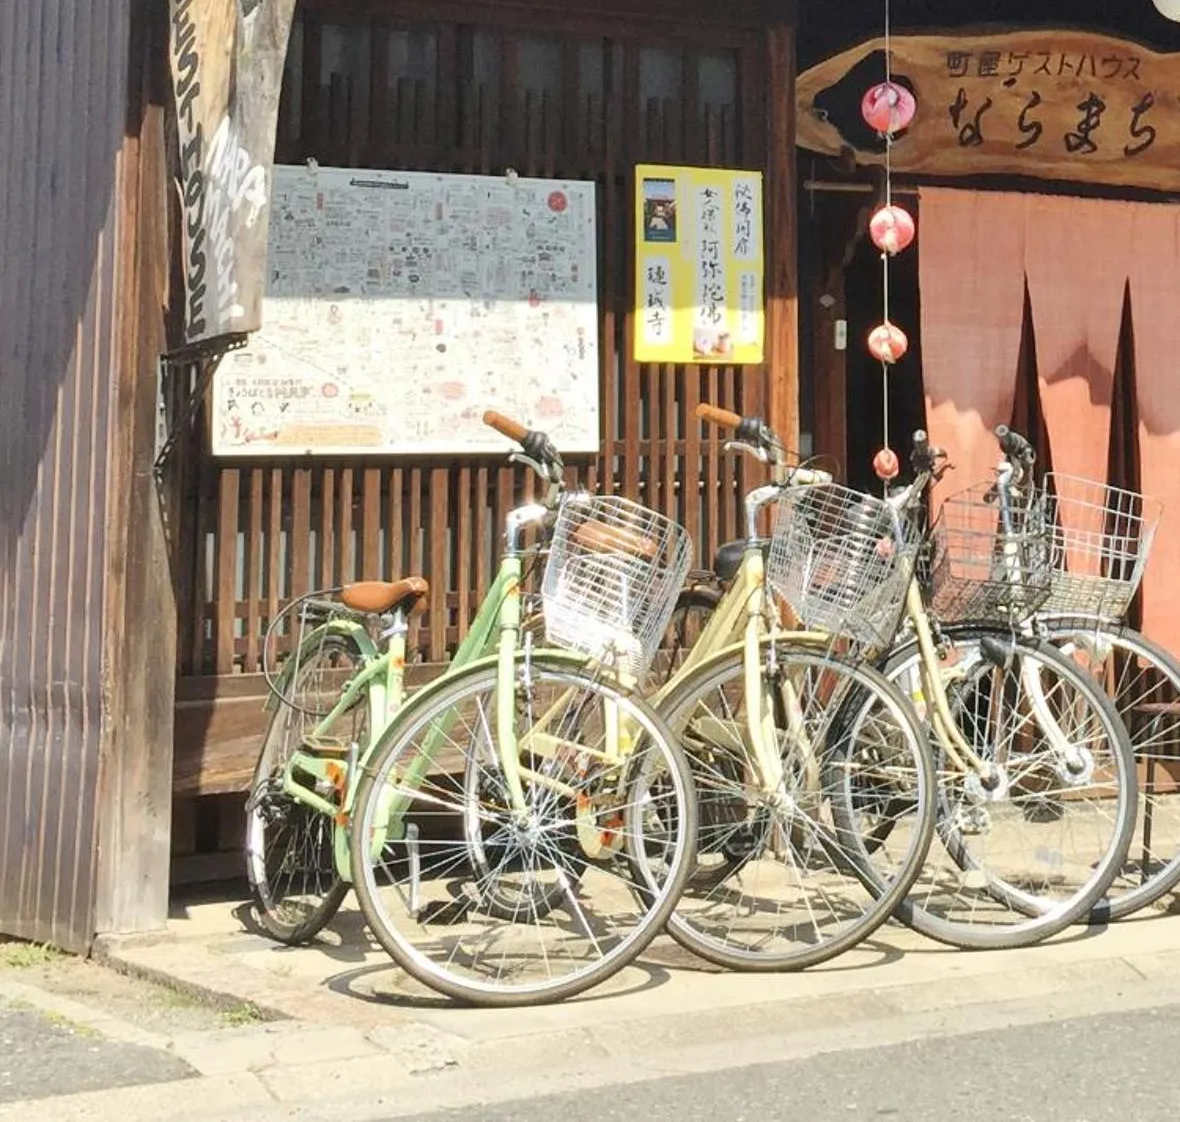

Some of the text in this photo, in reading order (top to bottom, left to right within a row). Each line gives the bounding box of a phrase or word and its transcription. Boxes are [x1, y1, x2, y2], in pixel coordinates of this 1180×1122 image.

[946, 48, 1143, 80] 町屋ゲストハウス
[948, 78, 1156, 158] ならまち
[181, 121, 207, 338] HOUSE
